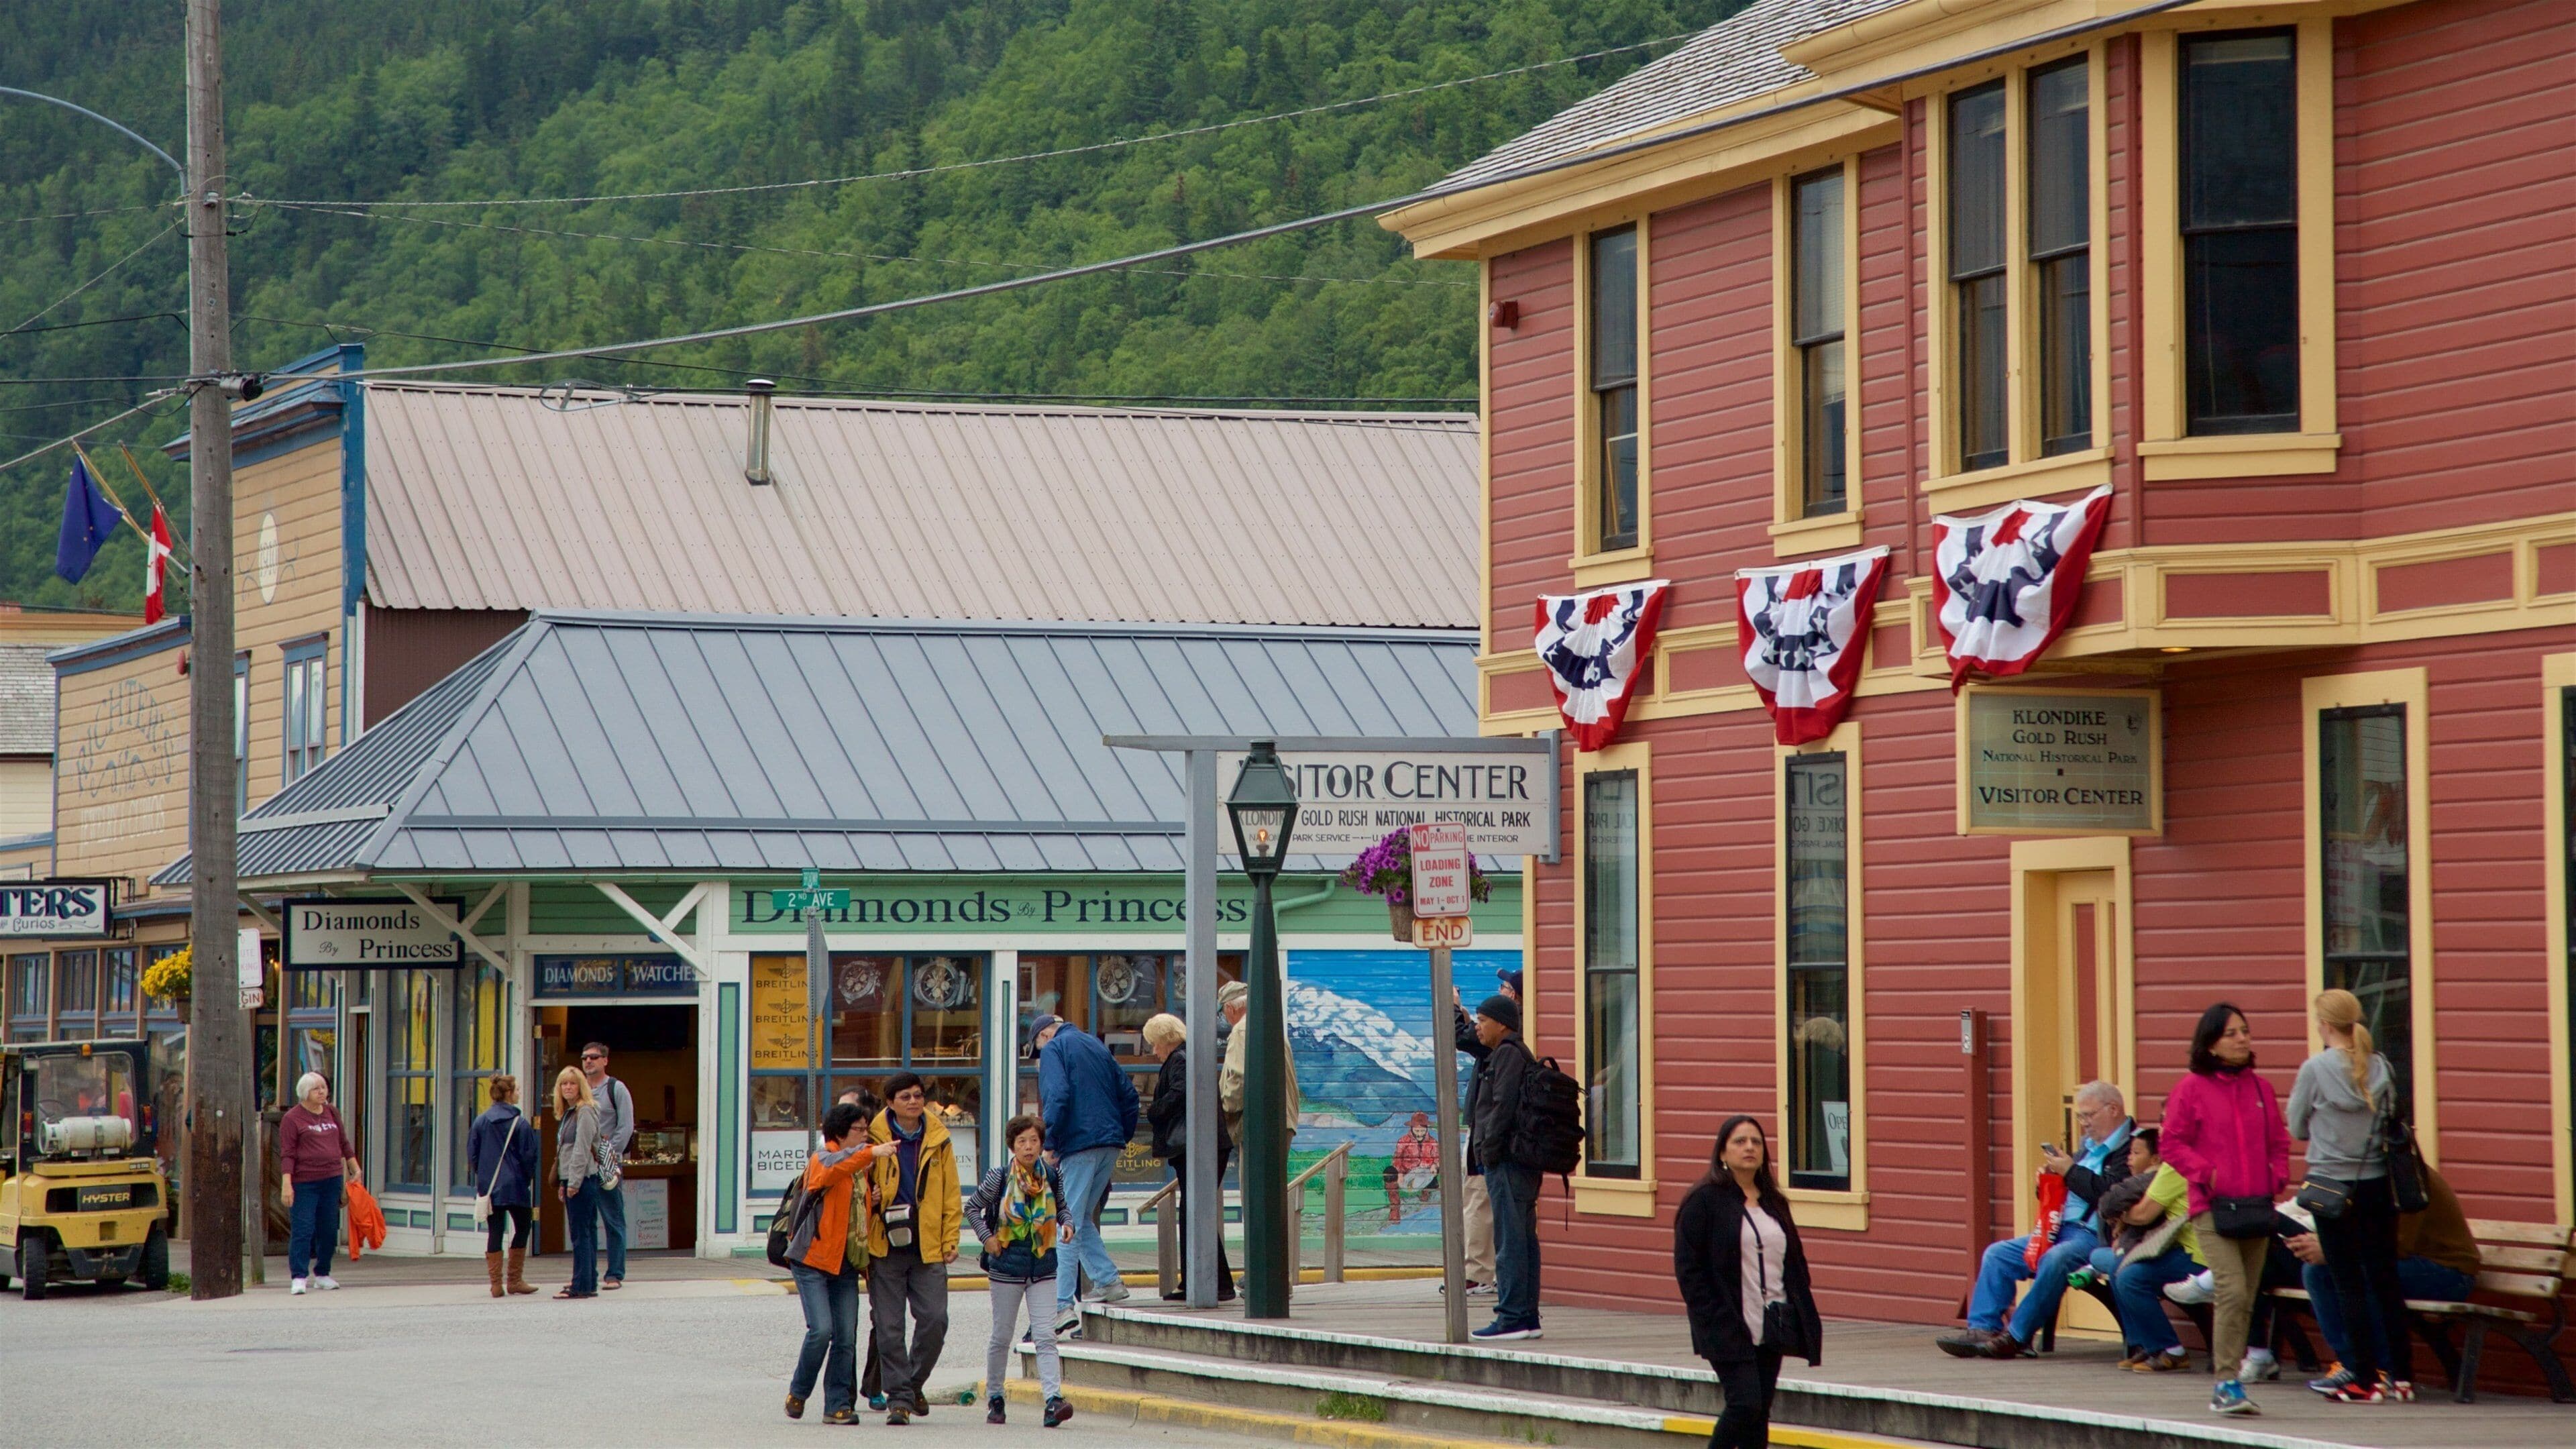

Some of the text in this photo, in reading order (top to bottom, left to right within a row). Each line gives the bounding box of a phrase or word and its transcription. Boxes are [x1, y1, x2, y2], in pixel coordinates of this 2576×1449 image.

[2012, 710, 2107, 727] KLONDIKE
[2012, 729, 2108, 745] GOLD RUSH
[1983, 749, 2138, 763] NATIONAL HISTORICAL PARK
[1384, 761, 1529, 800] CENTER
[1978, 786, 2143, 805] VISITOR CENTER
[1238, 810, 1285, 826] KLONDIK
[1301, 810, 1333, 826] GOLD
[1339, 810, 1368, 826] RUSH
[1436, 811, 1496, 827] HISTORICAL
[1502, 811, 1531, 827] PARK
[1293, 834, 1314, 842] PARK
[1316, 834, 1350, 842] SERVICE
[1477, 835, 1519, 843] INTERIOR
[1413, 829, 1429, 848] NO
[1430, 830, 1463, 844] PARKING
[1420, 858, 1461, 871] LOADING
[1429, 875, 1454, 888] ZONE
[812, 892, 835, 907] AVE
[1420, 898, 1434, 906] MAY
[1447, 896, 1457, 904] OCT
[1017, 902, 1037, 918] By
[13, 918, 56, 932] Curios
[303, 910, 420, 930] Diamonds
[1422, 924, 1463, 941] END
[319, 938, 453, 959] By Princess
[544, 967, 613, 983] DIAMONDS
[756, 980, 808, 988] BREITLIN
[241, 993, 260, 1005] GIN
[1828, 1112, 1847, 1130] OPE
[759, 1149, 809, 1159] MARC
[757, 1161, 806, 1171] BICEG
[1116, 1159, 1161, 1168] EITLING
[82, 1192, 131, 1203] HYSTER
